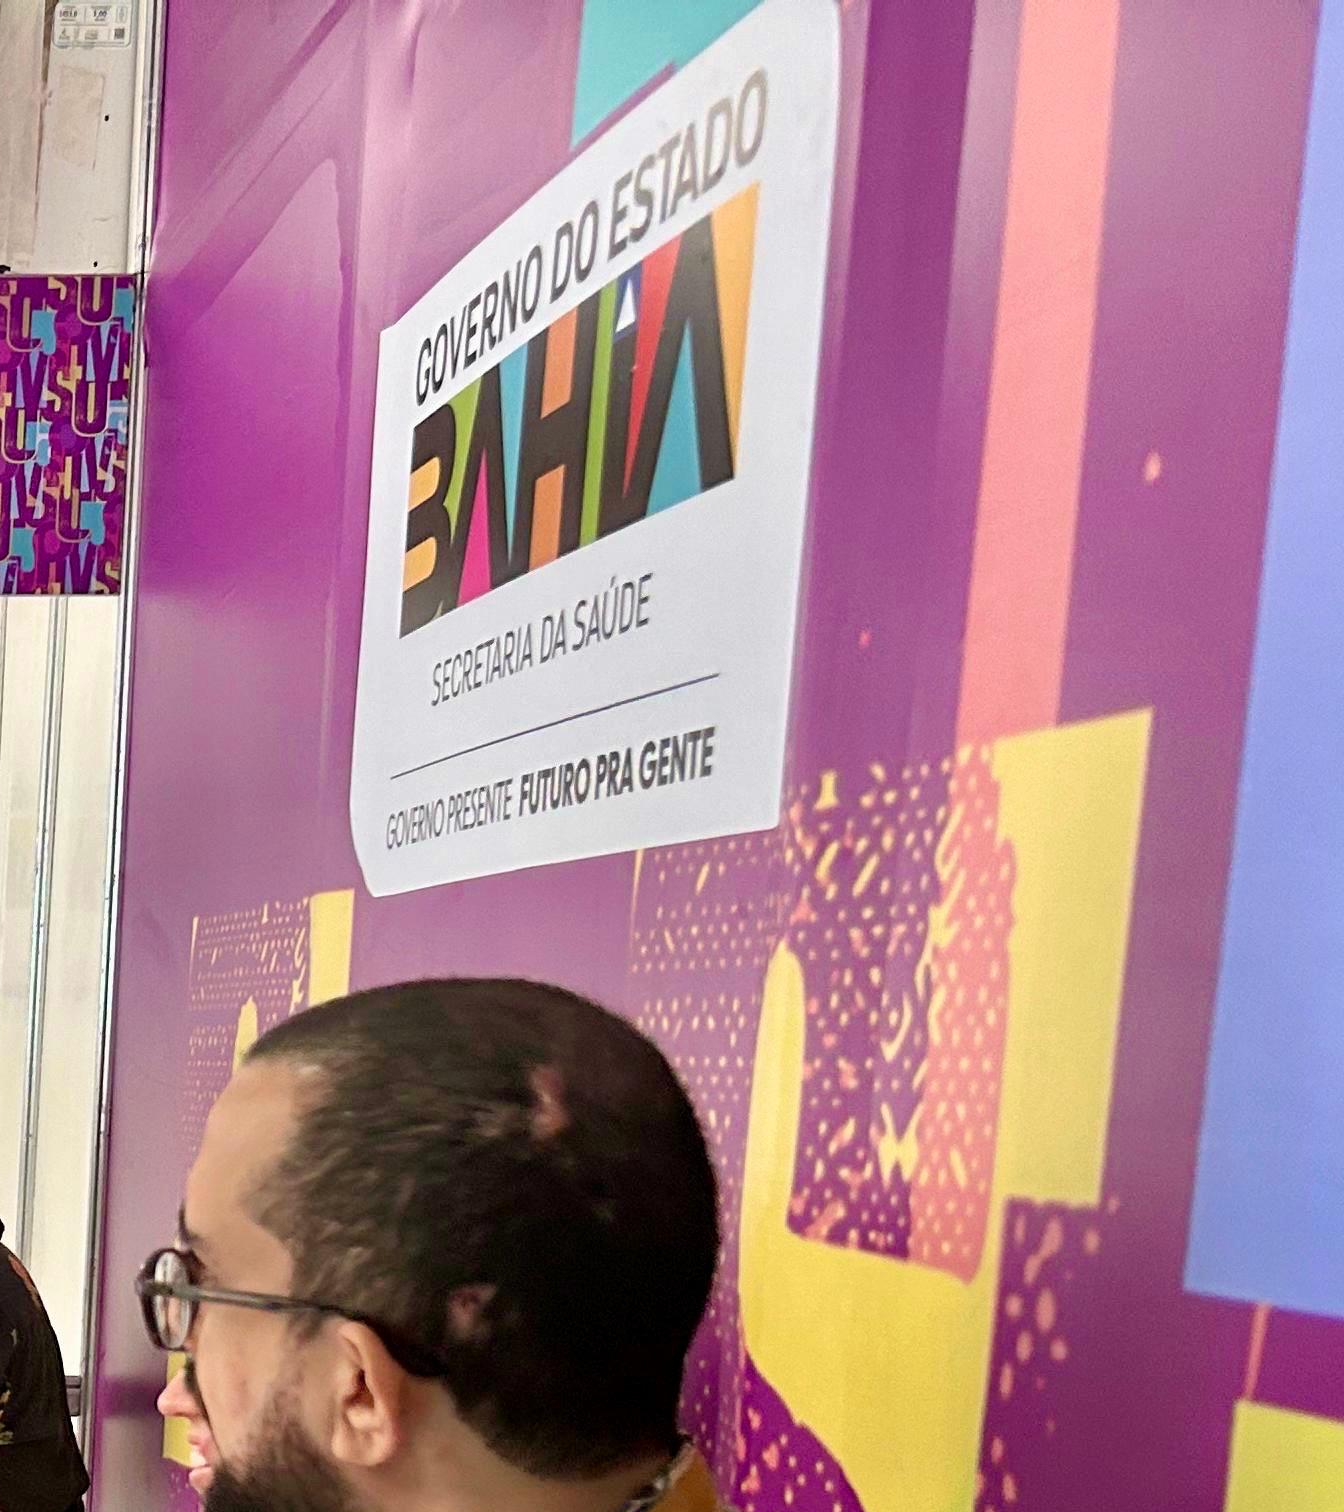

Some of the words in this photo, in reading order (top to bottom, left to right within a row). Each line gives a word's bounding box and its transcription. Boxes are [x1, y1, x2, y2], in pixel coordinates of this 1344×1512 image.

[416, 244, 542, 406] GOVERNO
[550, 199, 601, 304] DO
[607, 67, 769, 263] ESTADO
[399, 203, 738, 638] BAHIA
[431, 623, 533, 706] SECRETARIA
[539, 609, 567, 664] DA
[572, 572, 653, 651] SAÚDE
[386, 798, 444, 850] GOVERNO
[446, 778, 512, 833] PRESENTE
[518, 758, 590, 817] FUTURO
[594, 747, 634, 799] PRA
[639, 726, 715, 790] GENTE
